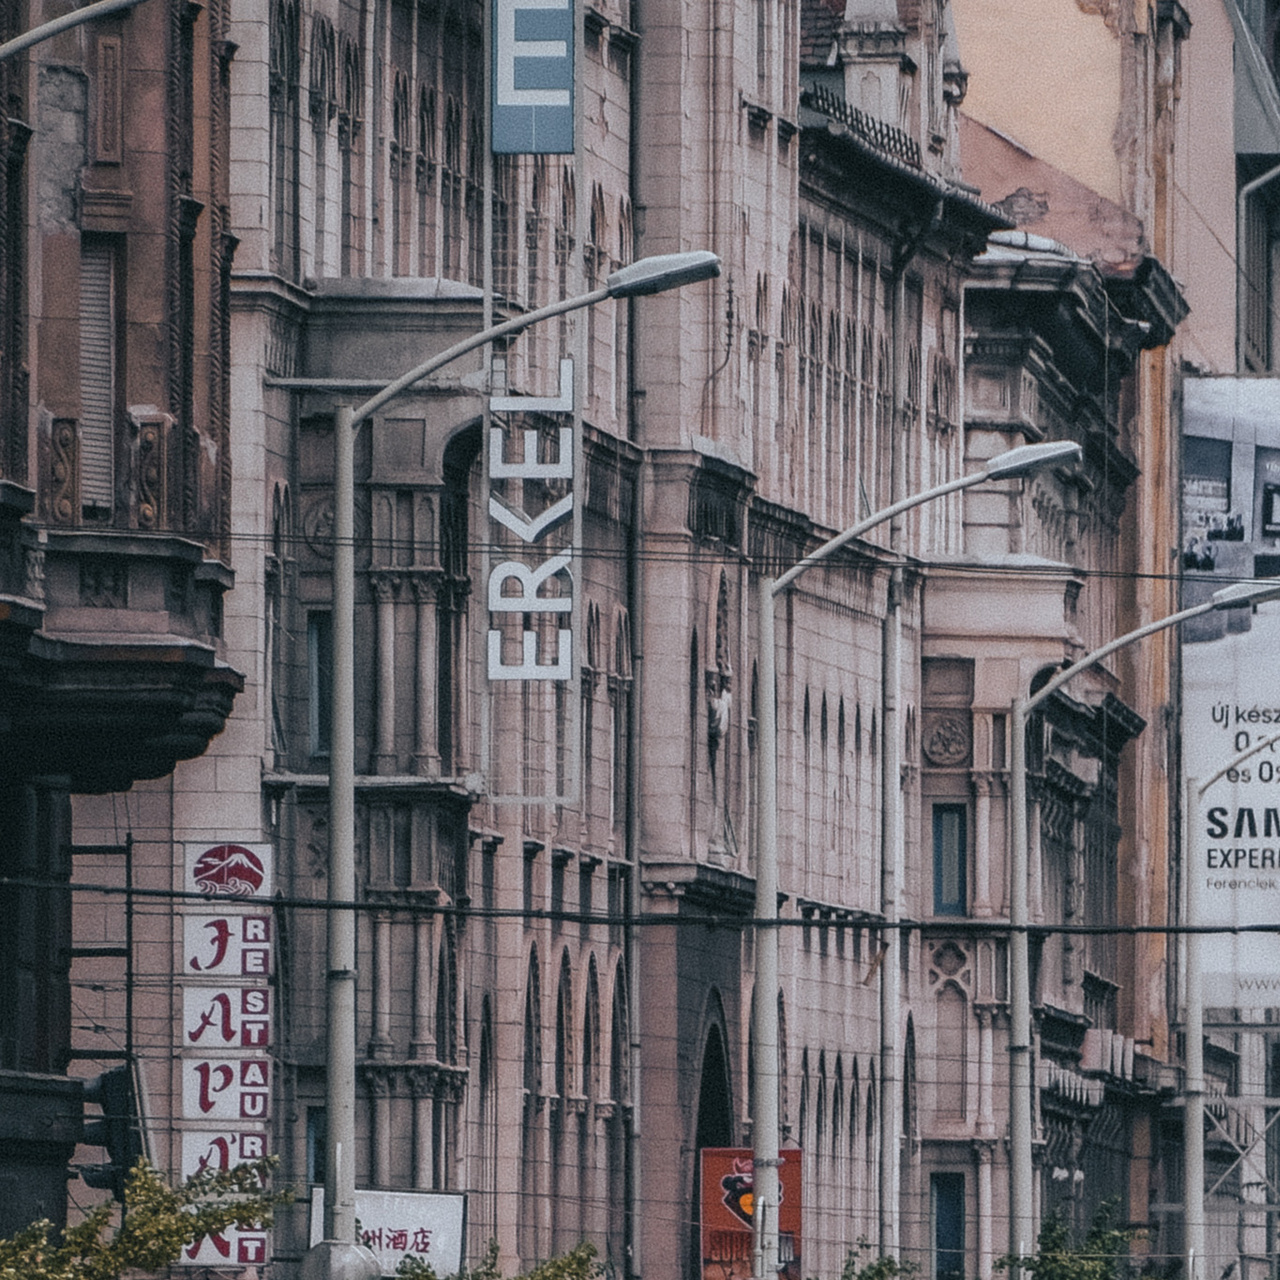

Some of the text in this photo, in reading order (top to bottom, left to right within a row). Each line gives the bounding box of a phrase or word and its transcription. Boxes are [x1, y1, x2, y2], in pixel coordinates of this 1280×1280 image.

[488, 357, 574, 681] ERKEL
[1211, 702, 1230, 730] Új
[243, 918, 267, 1261] RESTAURT
